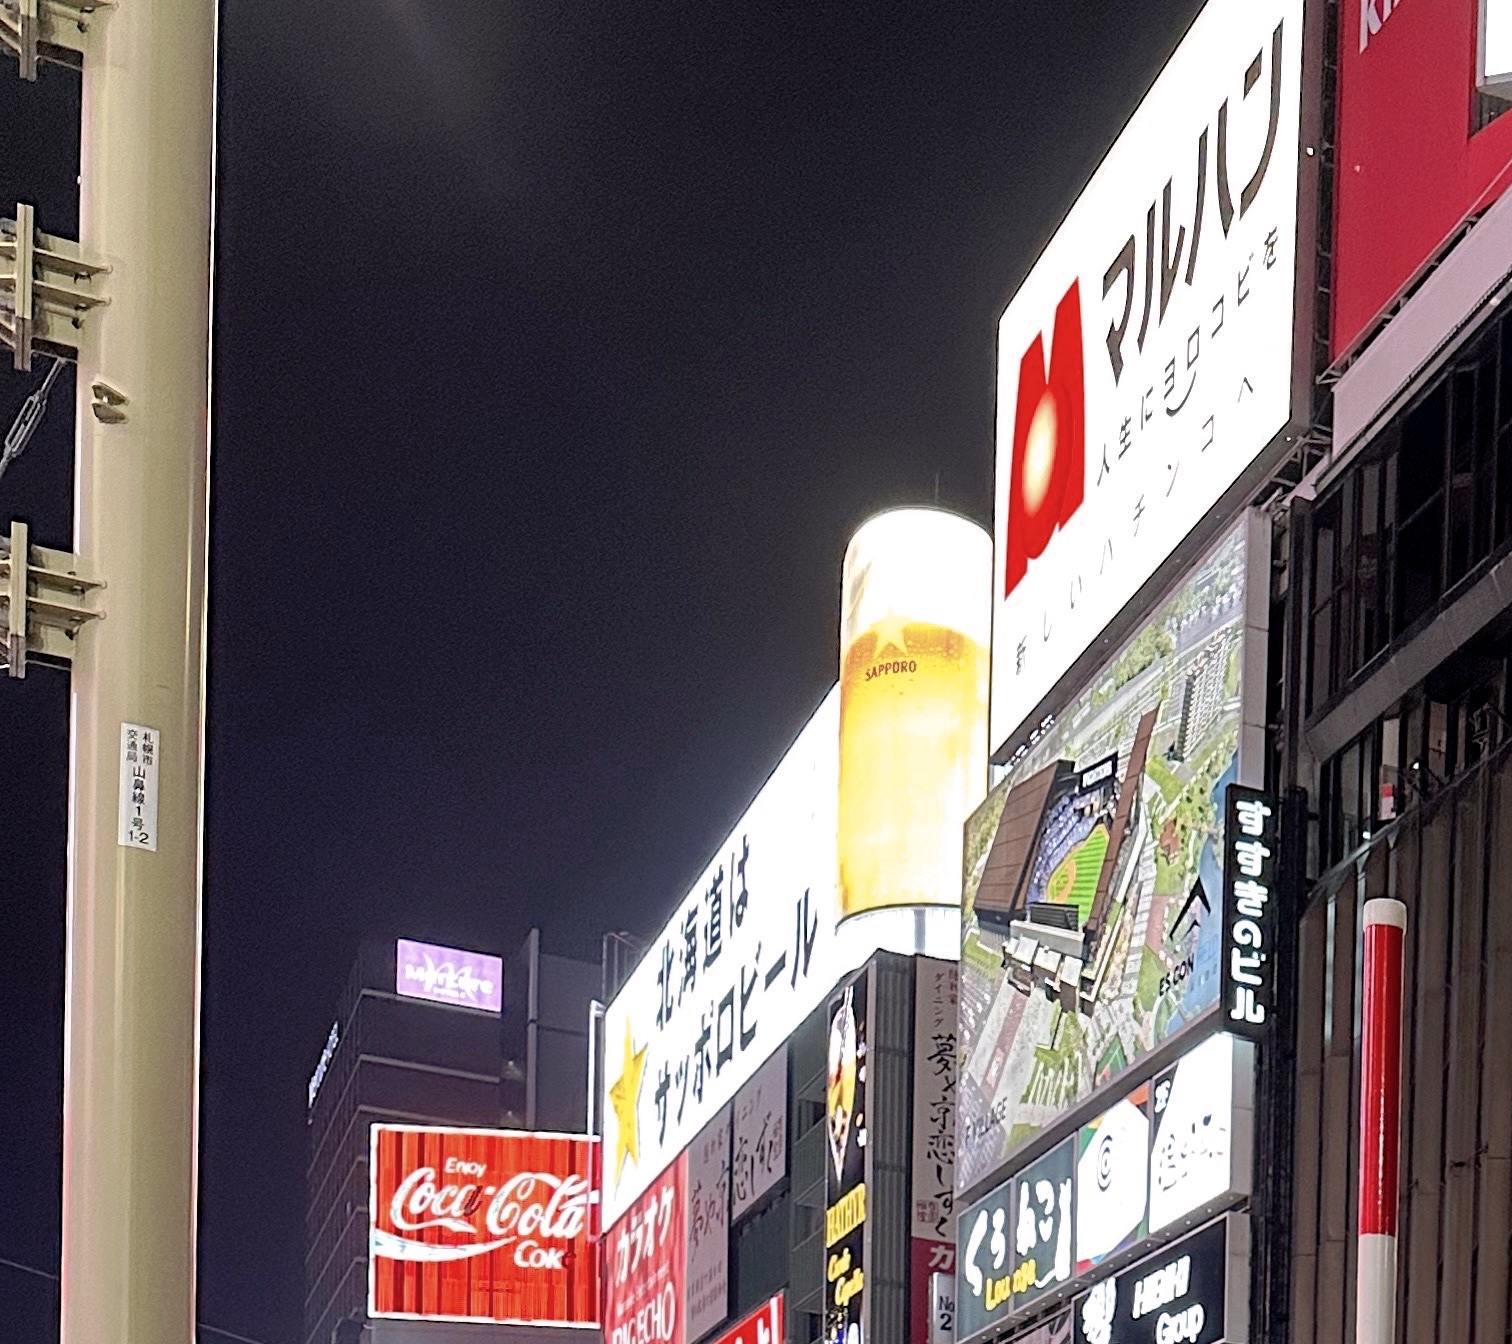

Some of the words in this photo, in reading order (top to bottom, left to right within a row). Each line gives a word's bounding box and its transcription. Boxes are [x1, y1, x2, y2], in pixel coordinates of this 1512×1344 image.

[1102, 17, 1285, 388] マルハン
[1097, 226, 1280, 487] 人生にヨロコビを
[865, 660, 917, 682] SAPPORO
[654, 886, 819, 1147] サッポロビール
[656, 834, 750, 1032] 北海道は
[1231, 799, 1272, 1025] すすきのビル
[390, 1167, 589, 1239] Coca-Cola
[445, 1157, 487, 1178] Enjoy
